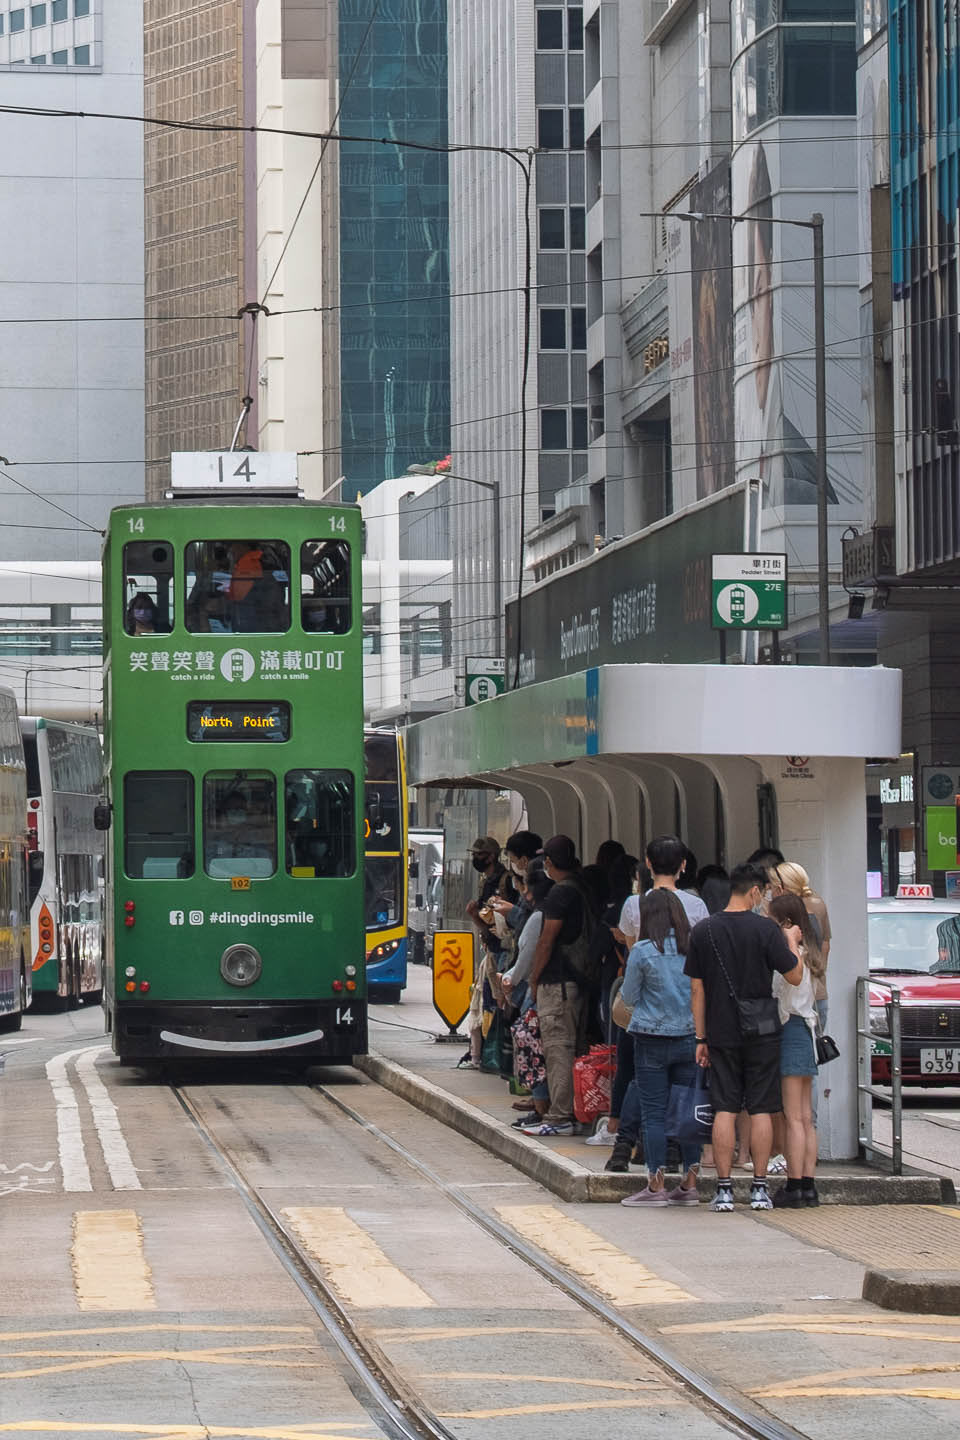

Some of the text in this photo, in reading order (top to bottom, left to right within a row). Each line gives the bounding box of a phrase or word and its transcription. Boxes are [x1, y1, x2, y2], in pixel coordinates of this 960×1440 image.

[217, 455, 257, 483] 14
[127, 517, 145, 534] 14
[328, 515, 347, 533] 14
[764, 583, 783, 592] 27E
[129, 650, 345, 672] 笑聲笑聲 滿載叮叮
[200, 673, 216, 681] ride
[289, 672, 310, 680] smile
[200, 716, 276, 728] North Point
[232, 879, 250, 888] 102
[900, 886, 930, 897] TAXI
[209, 911, 314, 927] #dingdingsmile
[336, 1007, 354, 1025] 14
[934, 1049, 954, 1061] LW
[924, 1060, 960, 1073] 939
